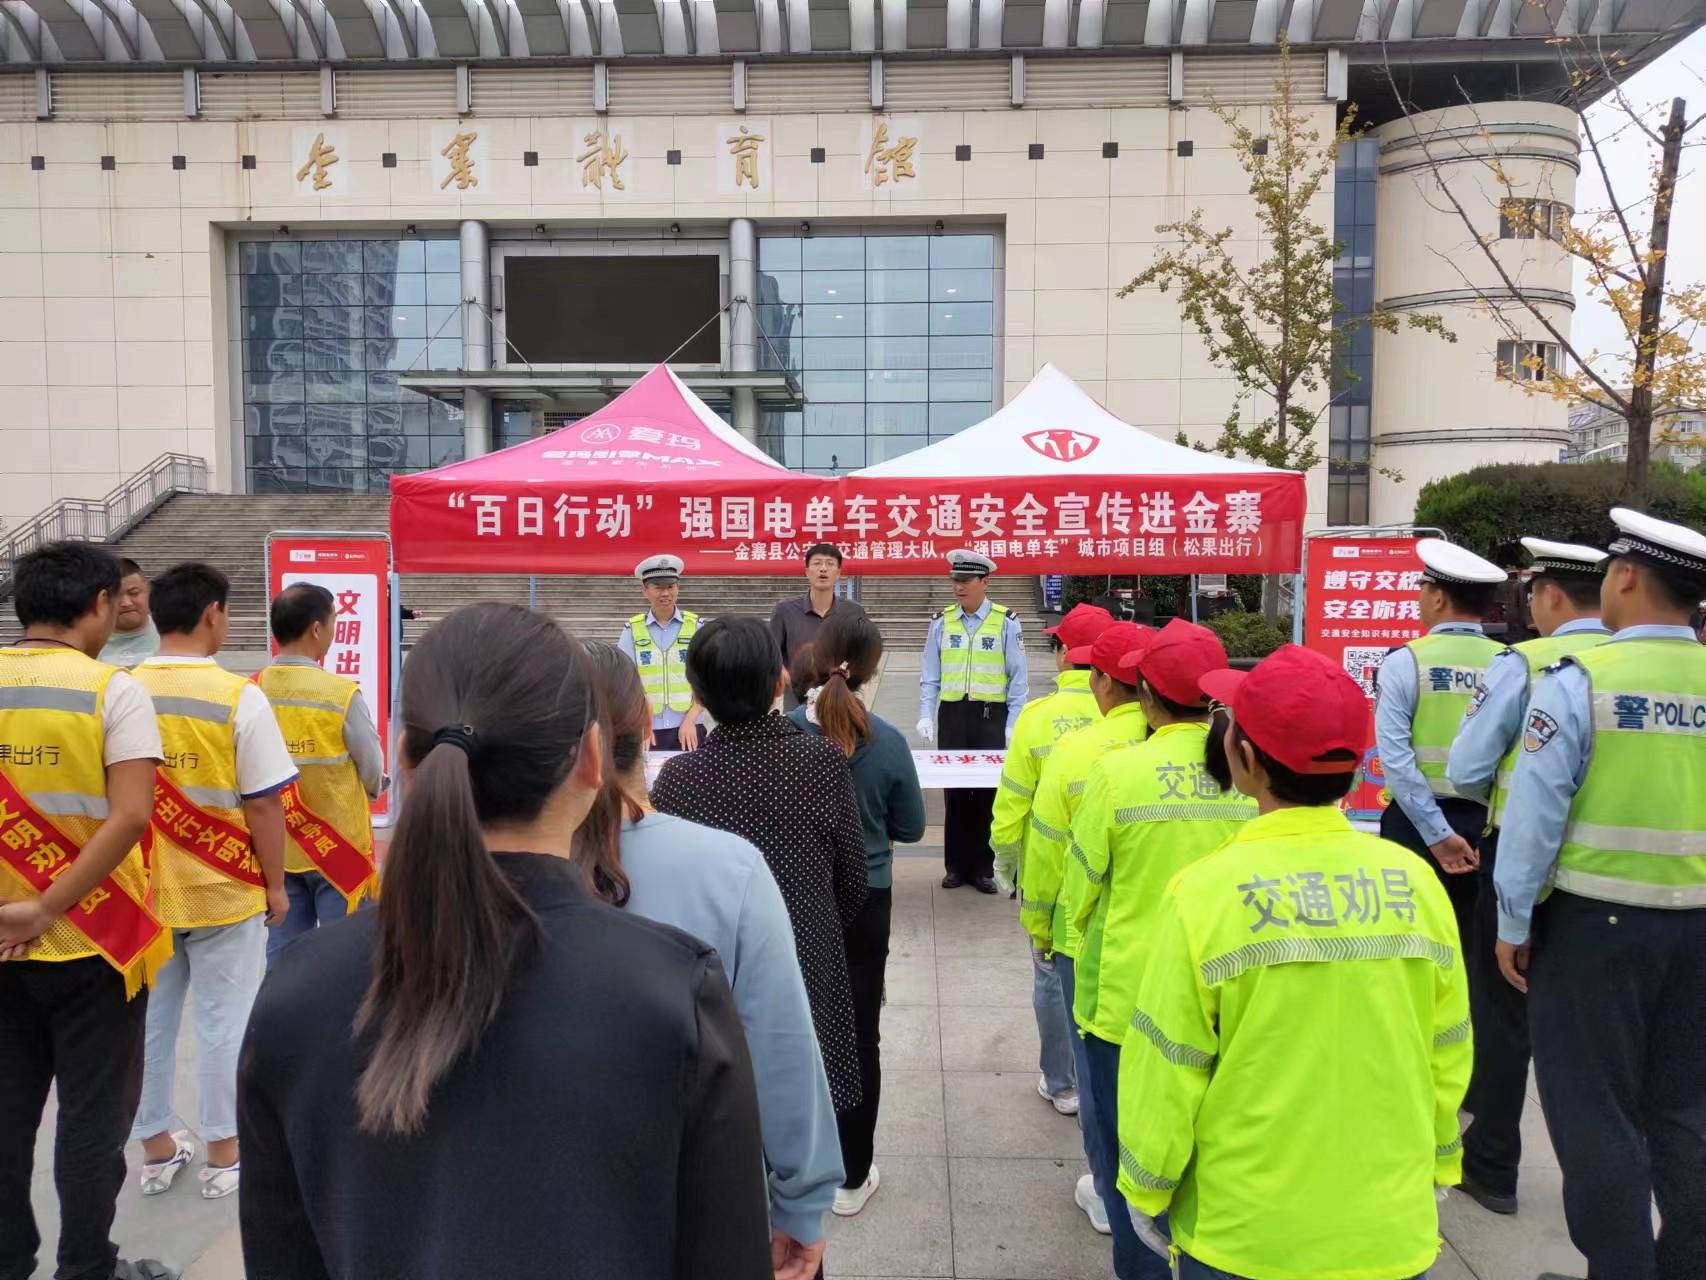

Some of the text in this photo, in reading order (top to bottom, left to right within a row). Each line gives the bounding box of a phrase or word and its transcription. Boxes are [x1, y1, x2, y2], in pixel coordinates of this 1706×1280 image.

[679, 490, 1262, 540] 强国电单车交通安全宣传进金寨
[1321, 600, 1421, 620] 安全你我
[335, 590, 362, 685] 文明出
[1614, 696, 1650, 730] 警
[1155, 761, 1248, 801] 交通
[1237, 867, 1417, 934] 交通劝导
